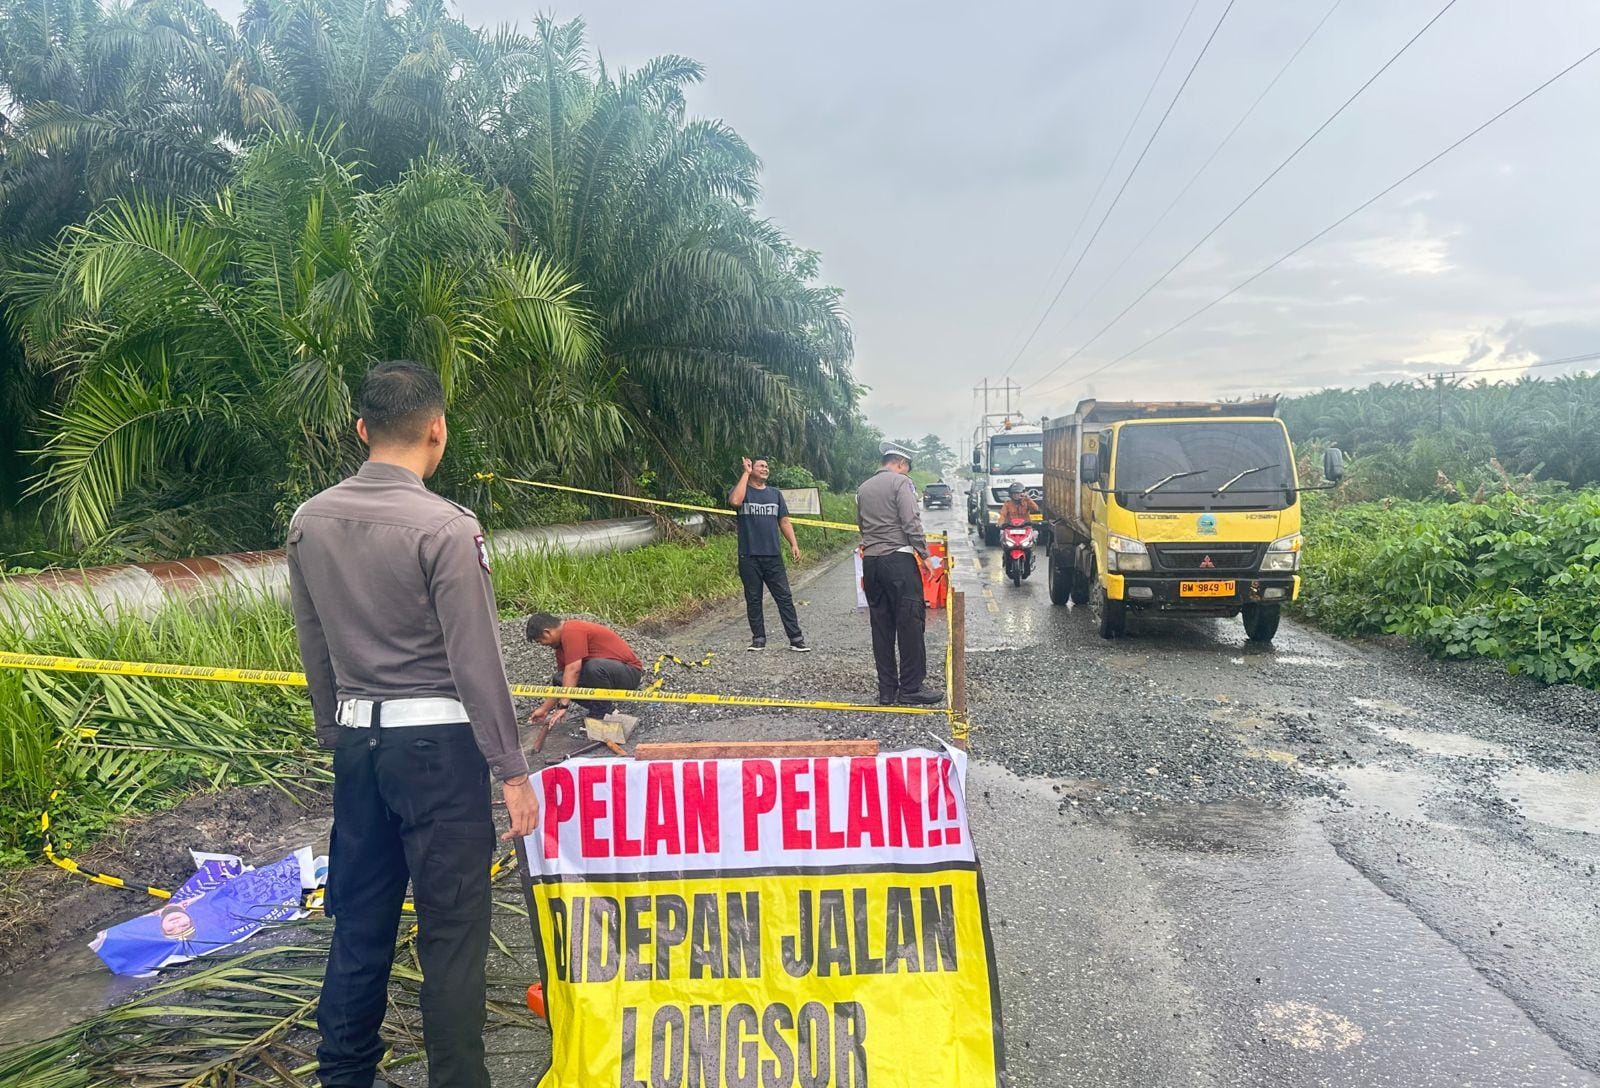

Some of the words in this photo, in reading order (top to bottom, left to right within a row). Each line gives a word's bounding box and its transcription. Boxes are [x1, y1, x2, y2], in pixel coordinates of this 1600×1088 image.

[1182, 583, 1194, 592] BM
[1198, 583, 1219, 592] 9849
[1225, 582, 1234, 591] TU
[541, 760, 720, 860] PELAN
[741, 756, 962, 853] PELAN!!
[547, 890, 761, 984] DIDEPAN
[780, 884, 959, 979] JALAN
[620, 1000, 869, 1088] LONGSOR
